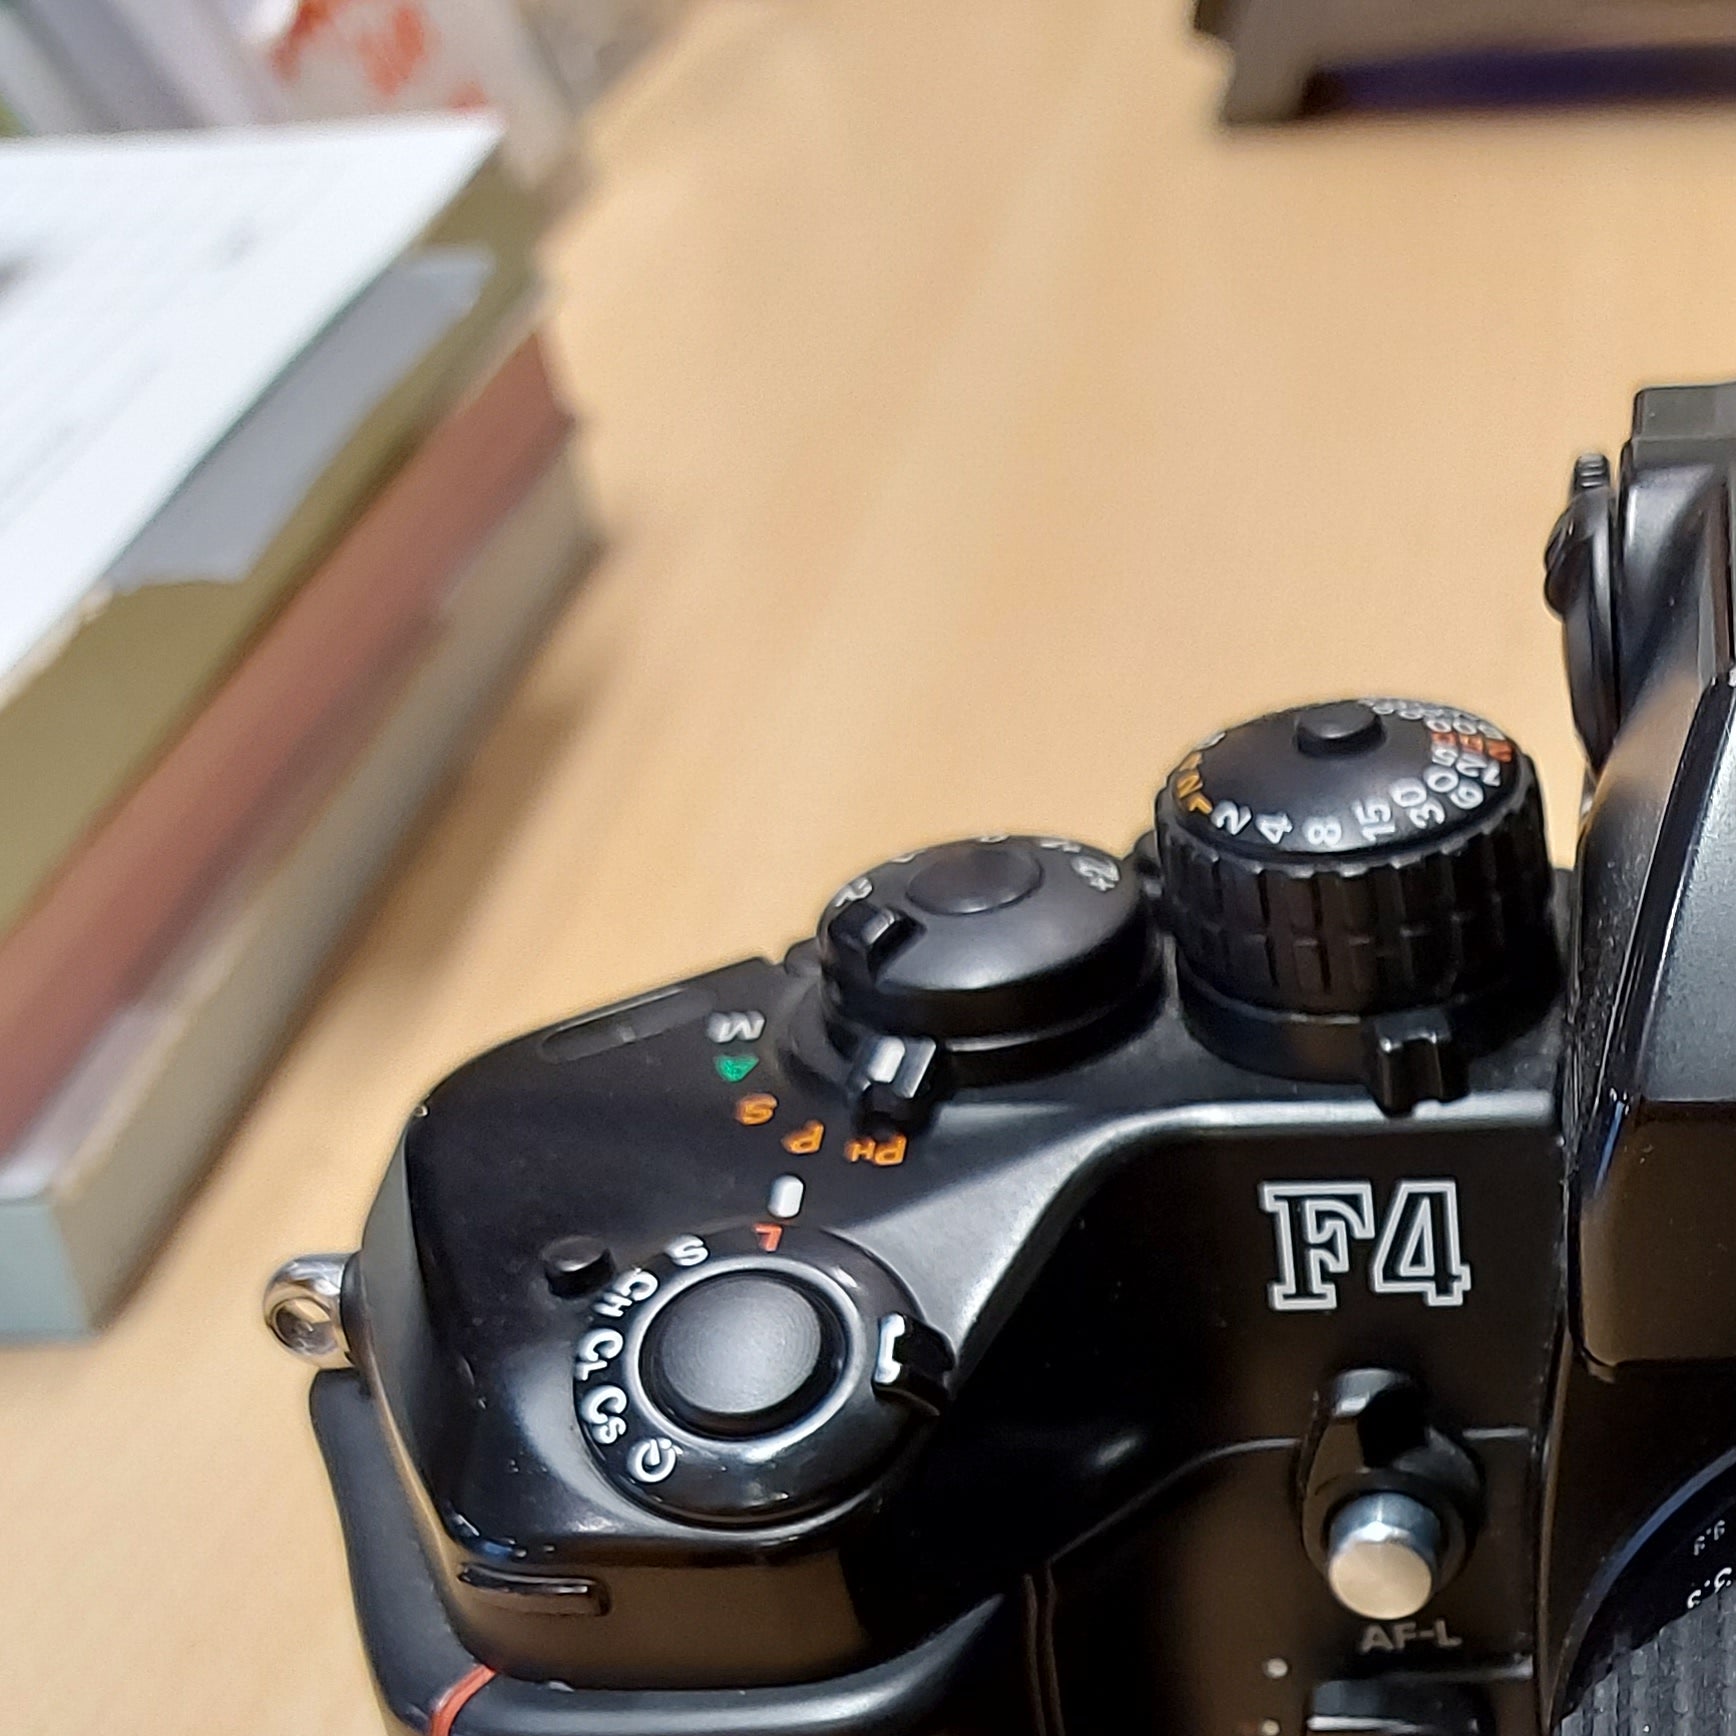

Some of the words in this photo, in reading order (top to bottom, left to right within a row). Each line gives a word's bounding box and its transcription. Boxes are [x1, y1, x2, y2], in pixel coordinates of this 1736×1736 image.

[1389, 776, 1445, 829] 30
[1423, 764, 1484, 809] 60
[1210, 800, 1252, 835] 2
[1254, 810, 1294, 844] 4
[1303, 815, 1342, 847] 8
[1354, 799, 1396, 842] 15
[707, 1010, 765, 1043] M
[734, 1092, 778, 1126] S
[780, 1119, 825, 1155] P
[663, 1234, 709, 1267] S
[1257, 1177, 1472, 1311] F4
[1357, 1618, 1463, 1654] AF-L
